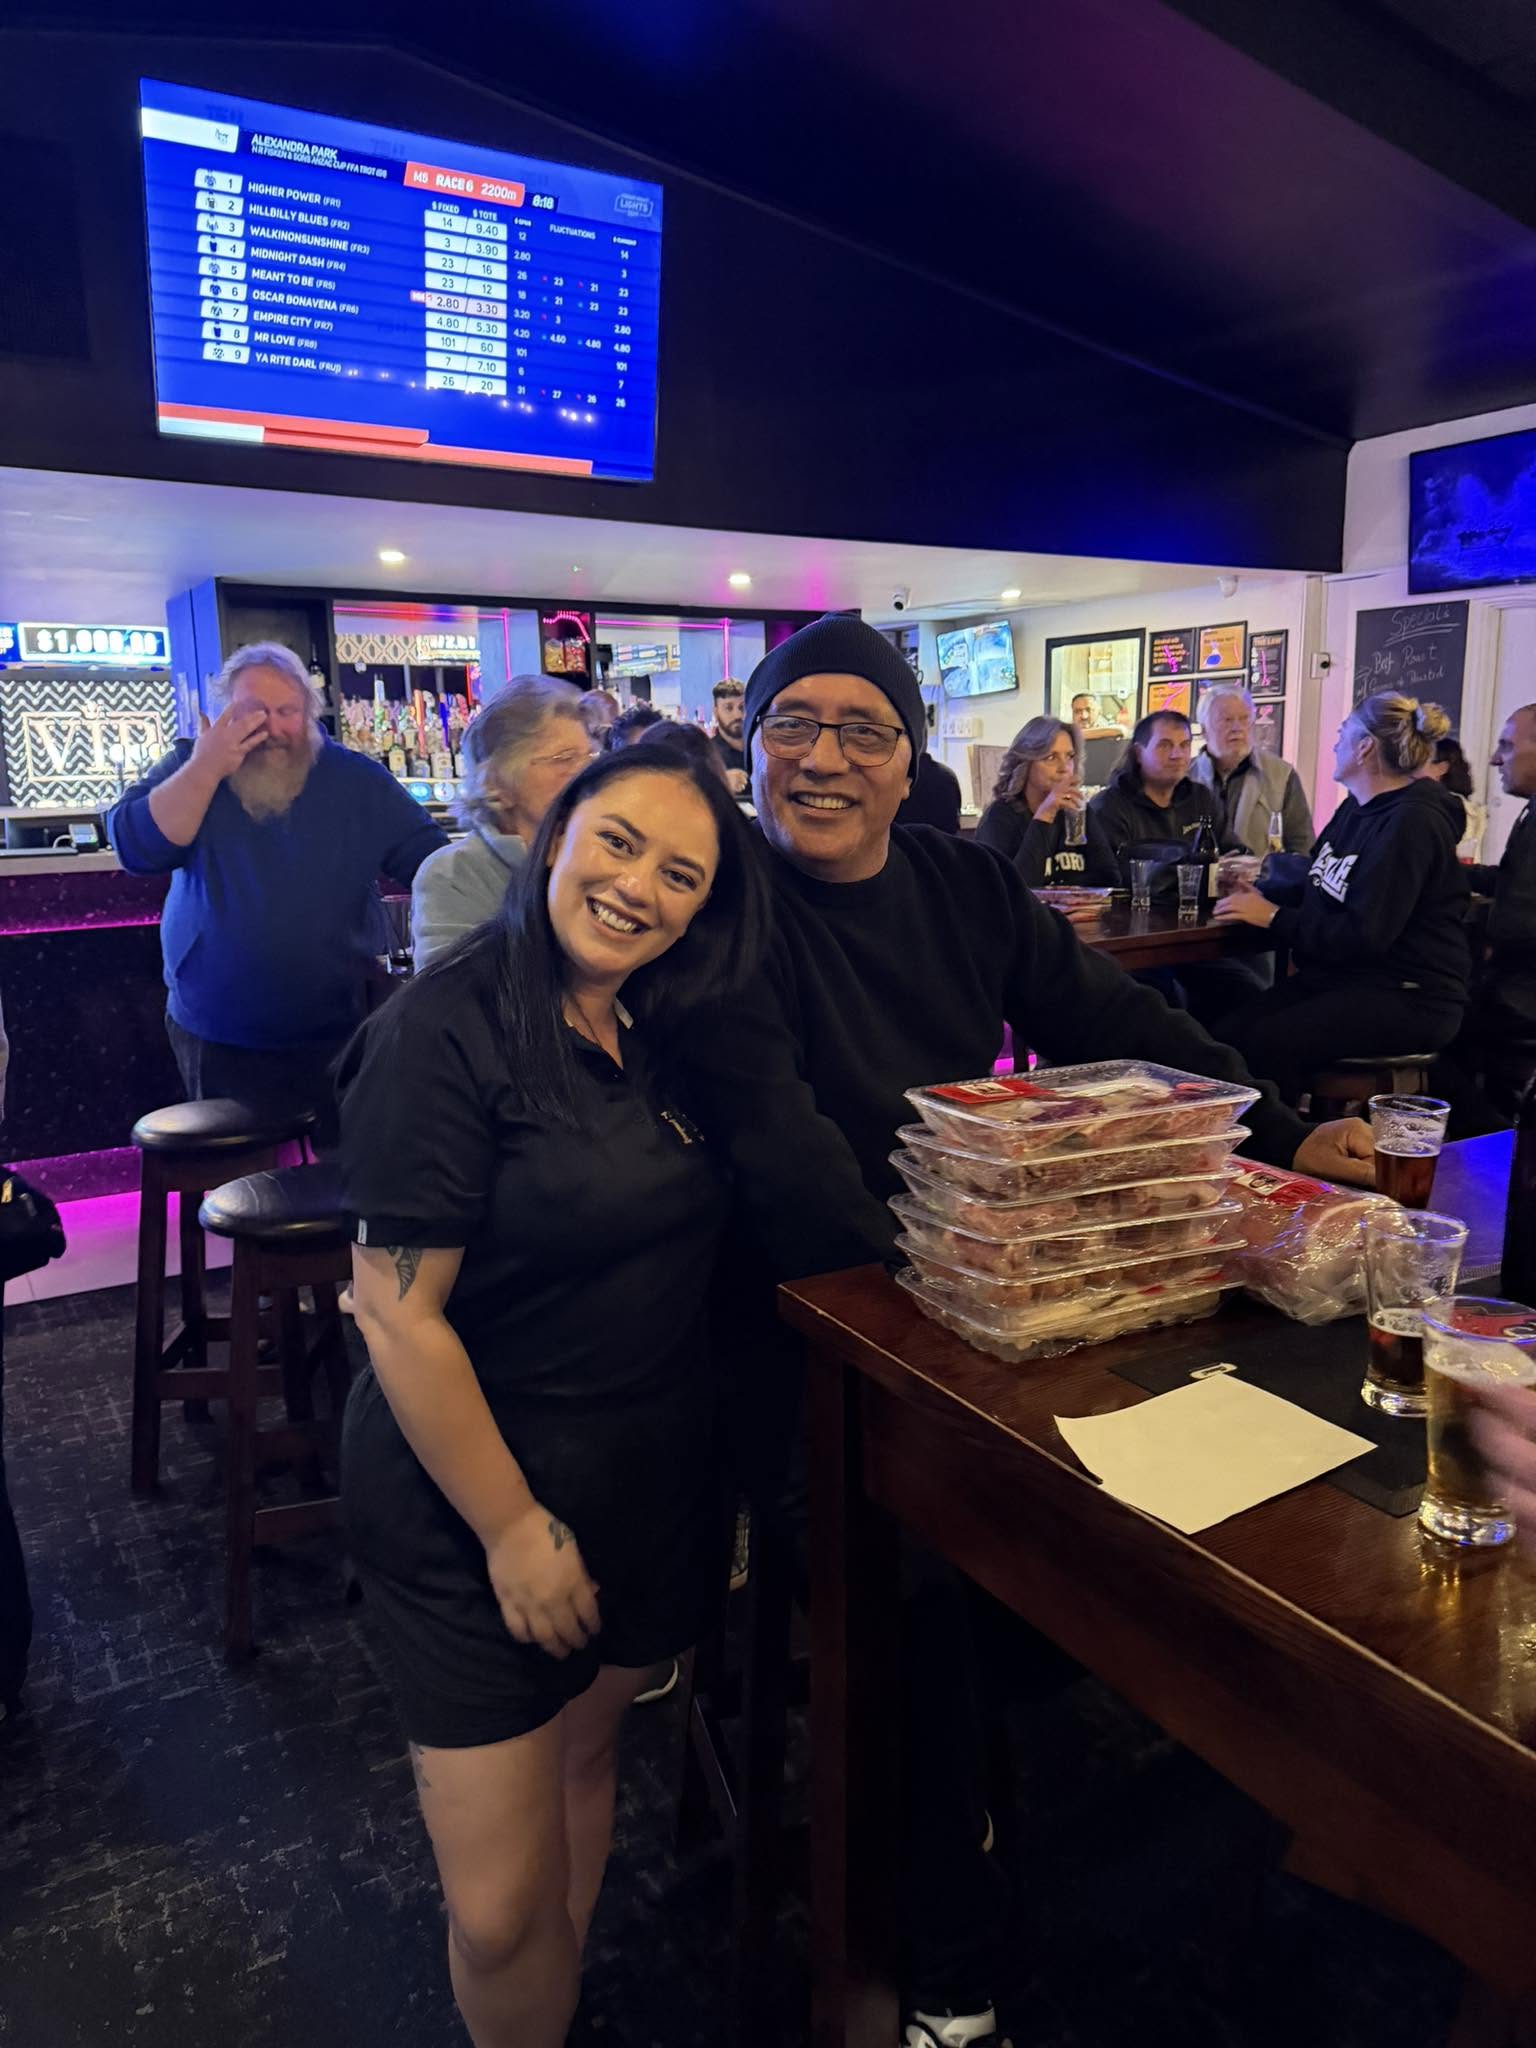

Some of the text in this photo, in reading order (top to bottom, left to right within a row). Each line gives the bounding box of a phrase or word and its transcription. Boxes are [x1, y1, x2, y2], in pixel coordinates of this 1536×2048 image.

[251, 134, 338, 160] ALEXANDRA PARK
[333, 160, 346, 170] CUP
[360, 165, 376, 176] TROT
[228, 178, 233, 188] 1
[248, 182, 285, 198] HIGHER
[286, 187, 321, 204] POWER
[436, 173, 465, 192] RACE
[480, 183, 517, 200] 2200m
[228, 200, 350, 231] 2 HILLBILLY BLUES (FR2)
[438, 202, 460, 214] FIXED
[478, 210, 497, 221] TOTE
[442, 217, 499, 236] 14 9.40
[550, 224, 596, 240] FLUCTUATIONS
[229, 222, 235, 232] 3
[250, 225, 348, 251] WALKINONSUNSHINE
[445, 237, 499, 256] 3 3.90
[620, 250, 629, 260] 14
[230, 244, 346, 272] 4 MIDNIGHT DASH (FR4)
[442, 257, 492, 275] 23 16
[231, 265, 237, 276] 5
[252, 268, 285, 282] MEANT
[287, 272, 300, 284] TO
[301, 275, 314, 287] BE
[442, 277, 492, 295] 23 12
[232, 286, 359, 315] 6 OSCAR BONAVENA (FR6)
[437, 296, 459, 309] 2.80
[476, 302, 498, 315] 3.30
[233, 308, 239, 318] 7
[253, 311, 289, 325] EMPIRE
[290, 316, 312, 328] CITY
[437, 317, 498, 334] 4.80 5.30
[234, 329, 240, 339] 8
[254, 331, 269, 343] MR
[270, 334, 295, 347] LOVE
[514, 328, 530, 339] 4.20
[441, 337, 494, 352] 101 60
[234, 350, 241, 360] 9
[255, 352, 268, 363] YA
[270, 354, 291, 366] RITE
[293, 357, 316, 370] DARL
[445, 356, 496, 372] 7 7.10
[516, 348, 627, 372] 101 101
[442, 376, 493, 391] 26 20
[618, 379, 624, 389] 7
[29, 718, 157, 772] VIP
